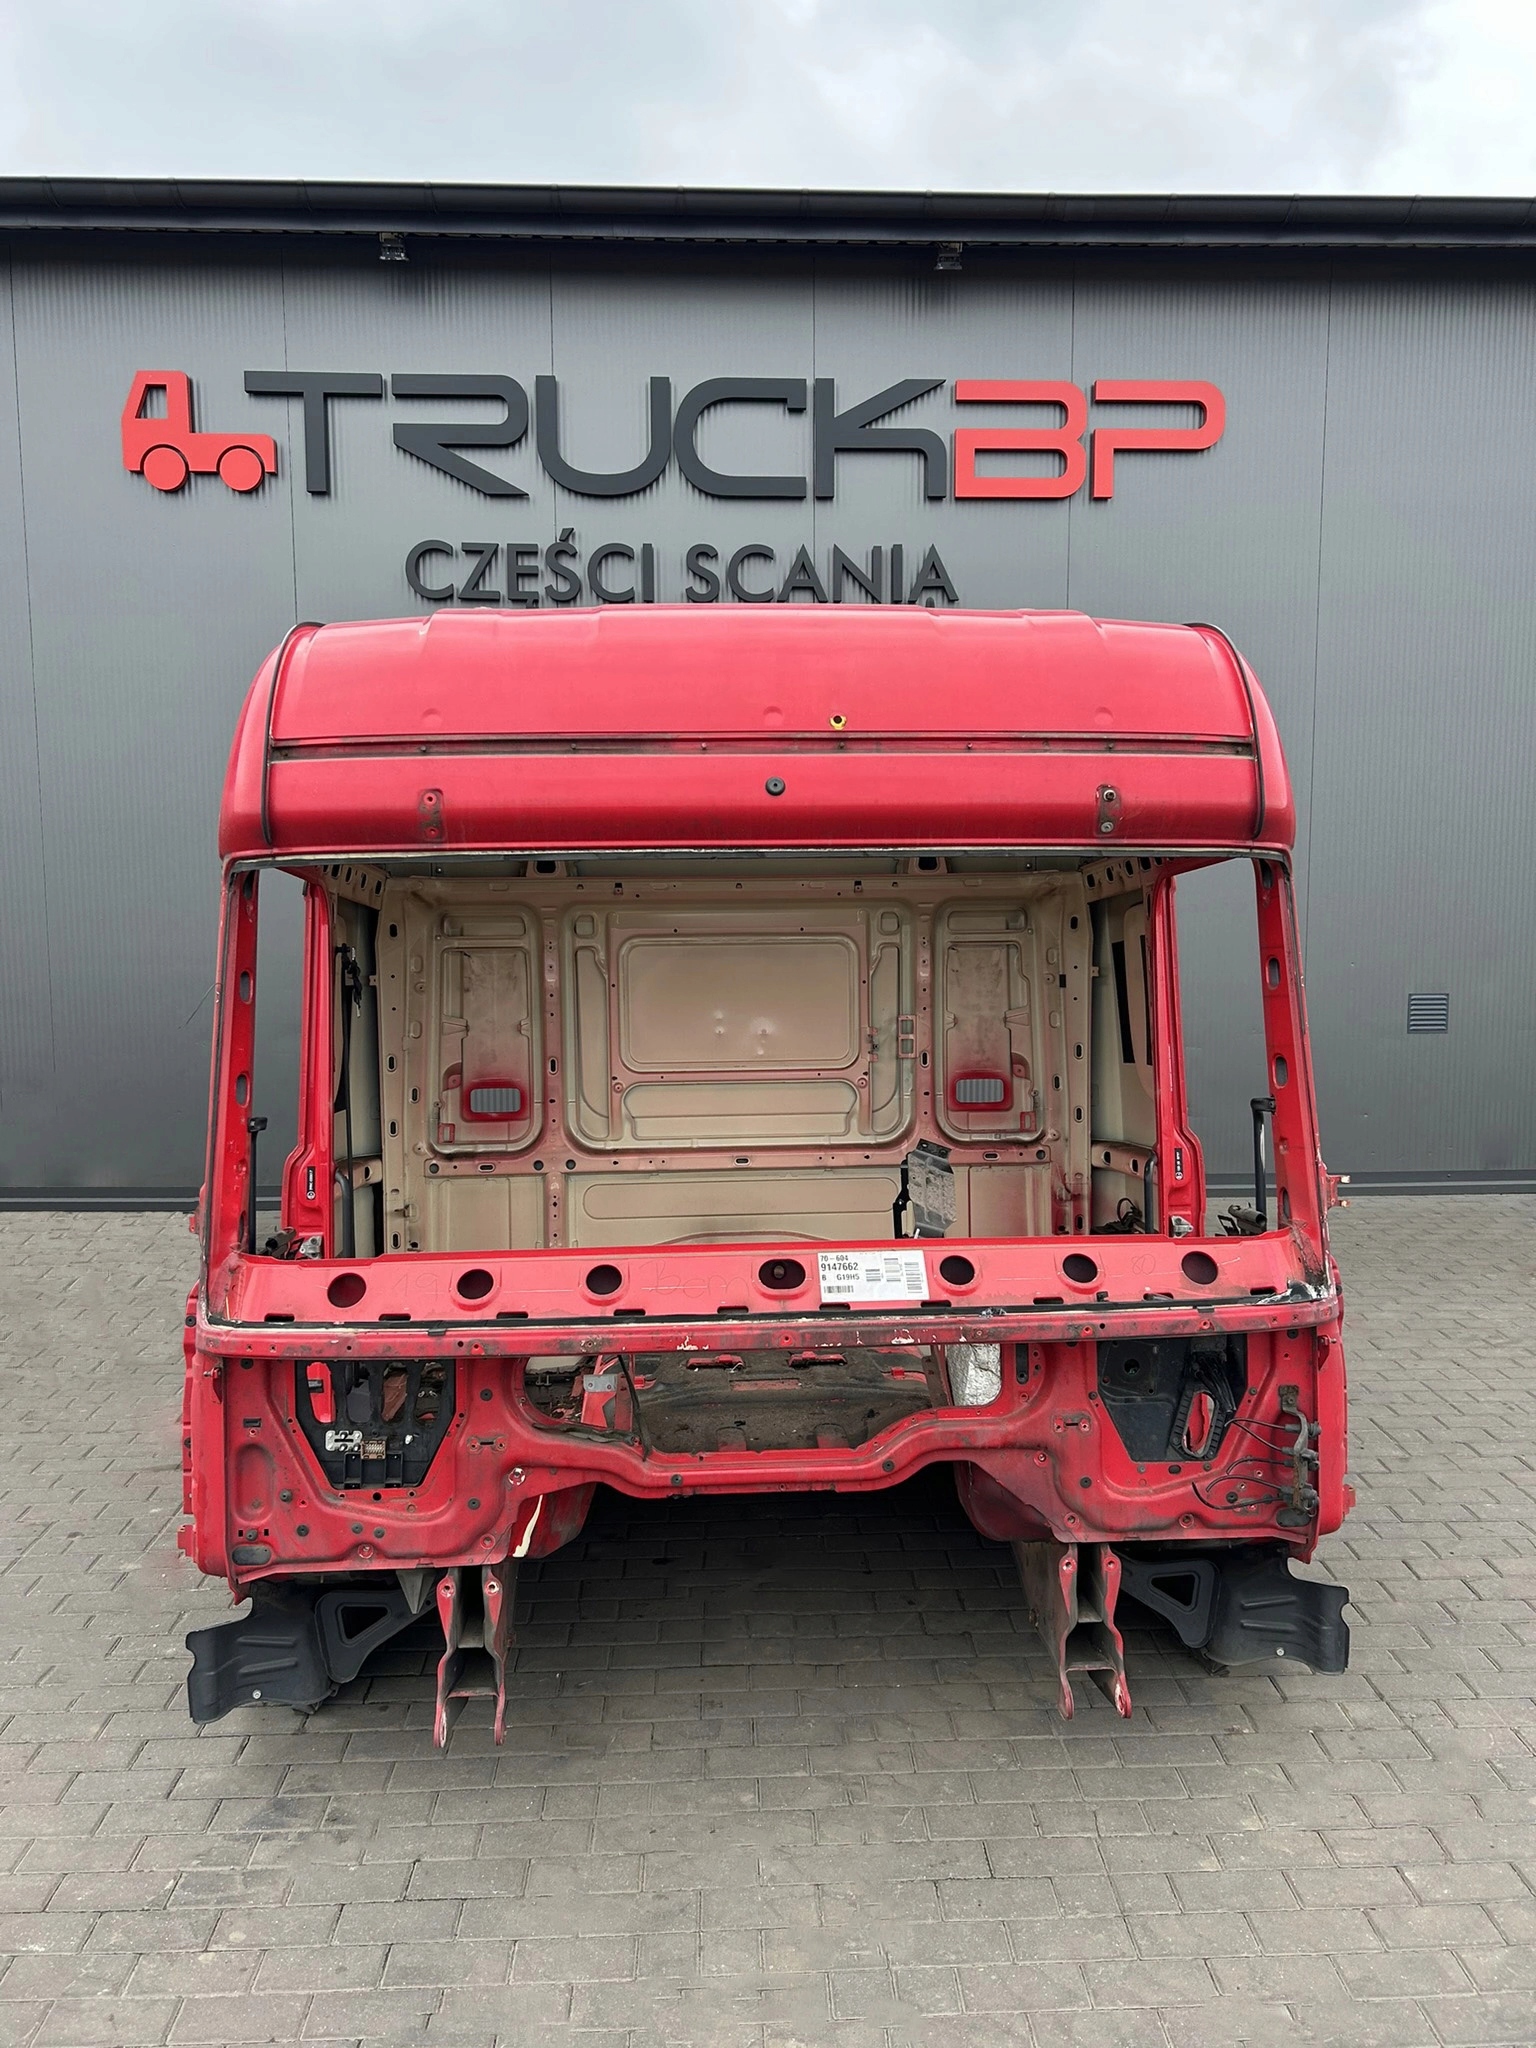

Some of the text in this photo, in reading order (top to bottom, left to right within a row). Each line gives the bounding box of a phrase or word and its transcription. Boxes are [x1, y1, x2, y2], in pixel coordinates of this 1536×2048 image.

[405, 528, 960, 608] CZĘŚCI SCANIA
[821, 1262, 858, 1272] 9147662
